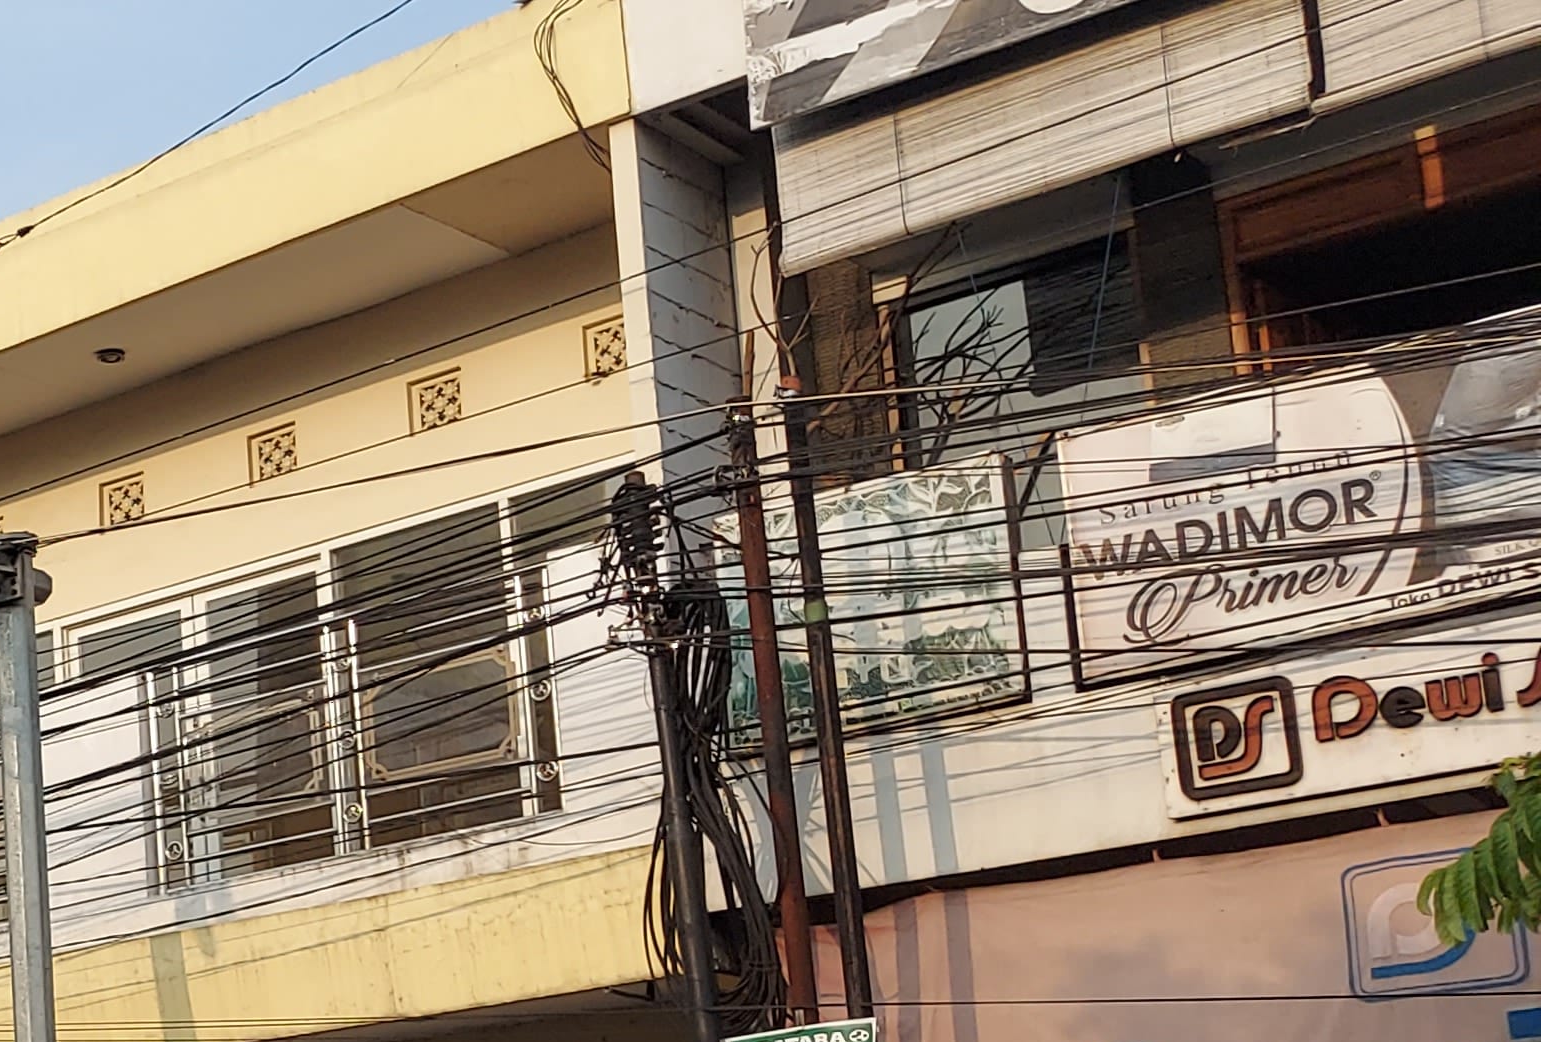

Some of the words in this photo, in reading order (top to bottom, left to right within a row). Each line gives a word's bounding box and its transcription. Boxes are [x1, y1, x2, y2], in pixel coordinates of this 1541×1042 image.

[1078, 476, 1379, 581] WADIMOR
[1123, 551, 1362, 644] Primer
[1311, 652, 1506, 743] Dewi
